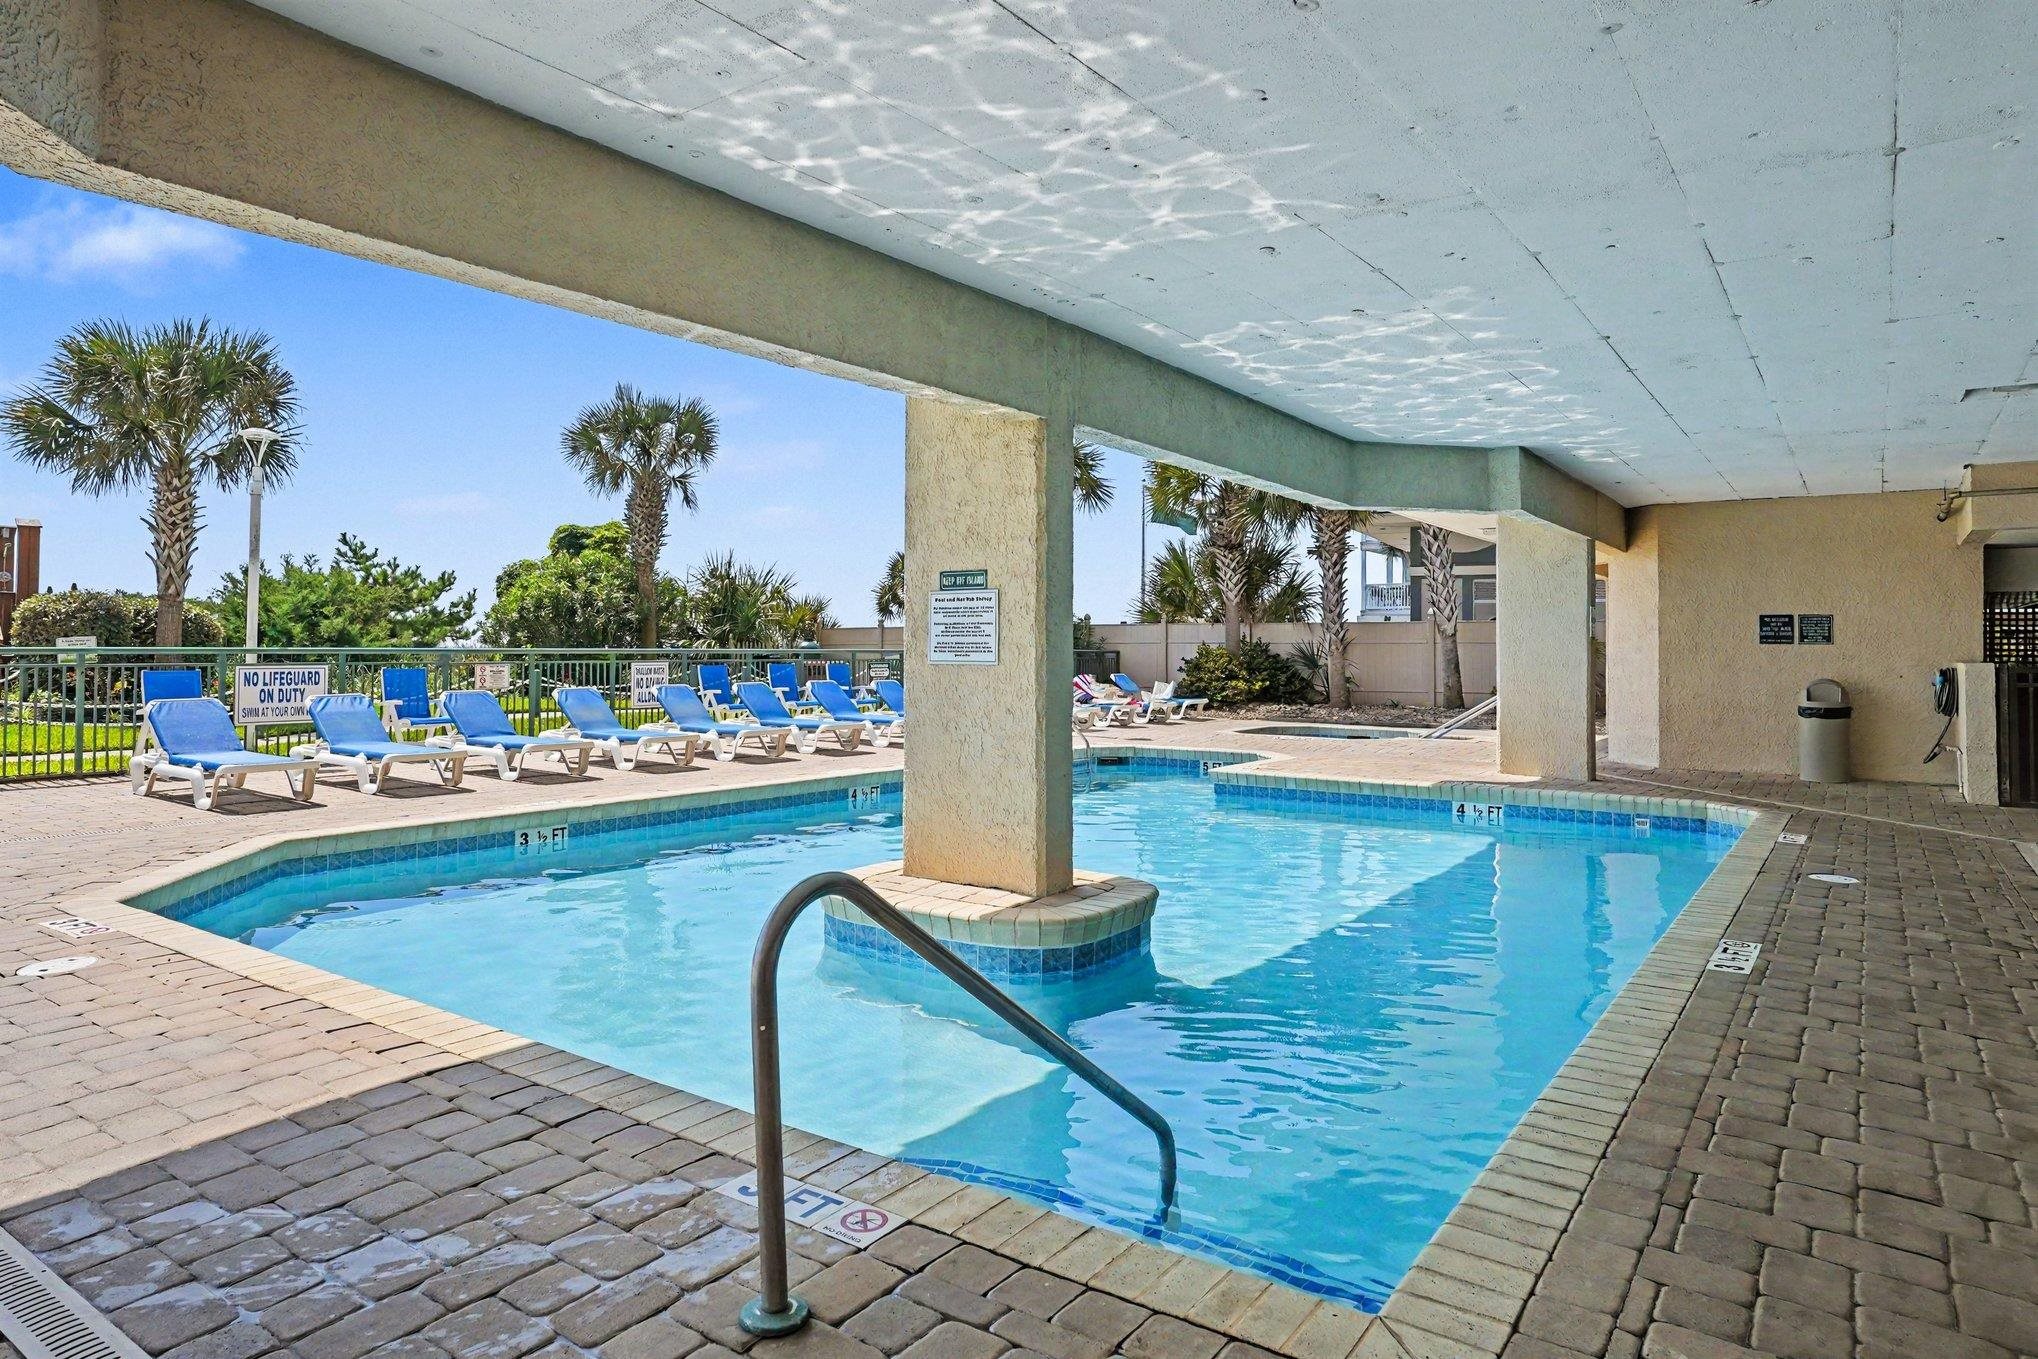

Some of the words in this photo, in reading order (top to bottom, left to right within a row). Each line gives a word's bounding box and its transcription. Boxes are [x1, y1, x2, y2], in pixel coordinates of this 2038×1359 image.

[243, 671, 259, 687] NO
[262, 671, 321, 687] LIFEGUARD
[259, 688, 274, 704] ON
[277, 687, 306, 703] DUTY
[242, 707, 259, 718] SWIM
[261, 707, 269, 718] AT
[271, 706, 289, 717] YOUR
[290, 706, 305, 717] OWN
[1202, 761, 1209, 771] 5
[851, 788, 858, 800] 4
[870, 785, 880, 799] FT
[1456, 803, 1466, 815] 4
[1487, 805, 1503, 818] FT
[519, 832, 529, 846] 3
[552, 826, 567, 841] FT
[784, 1187, 845, 1219] FT
